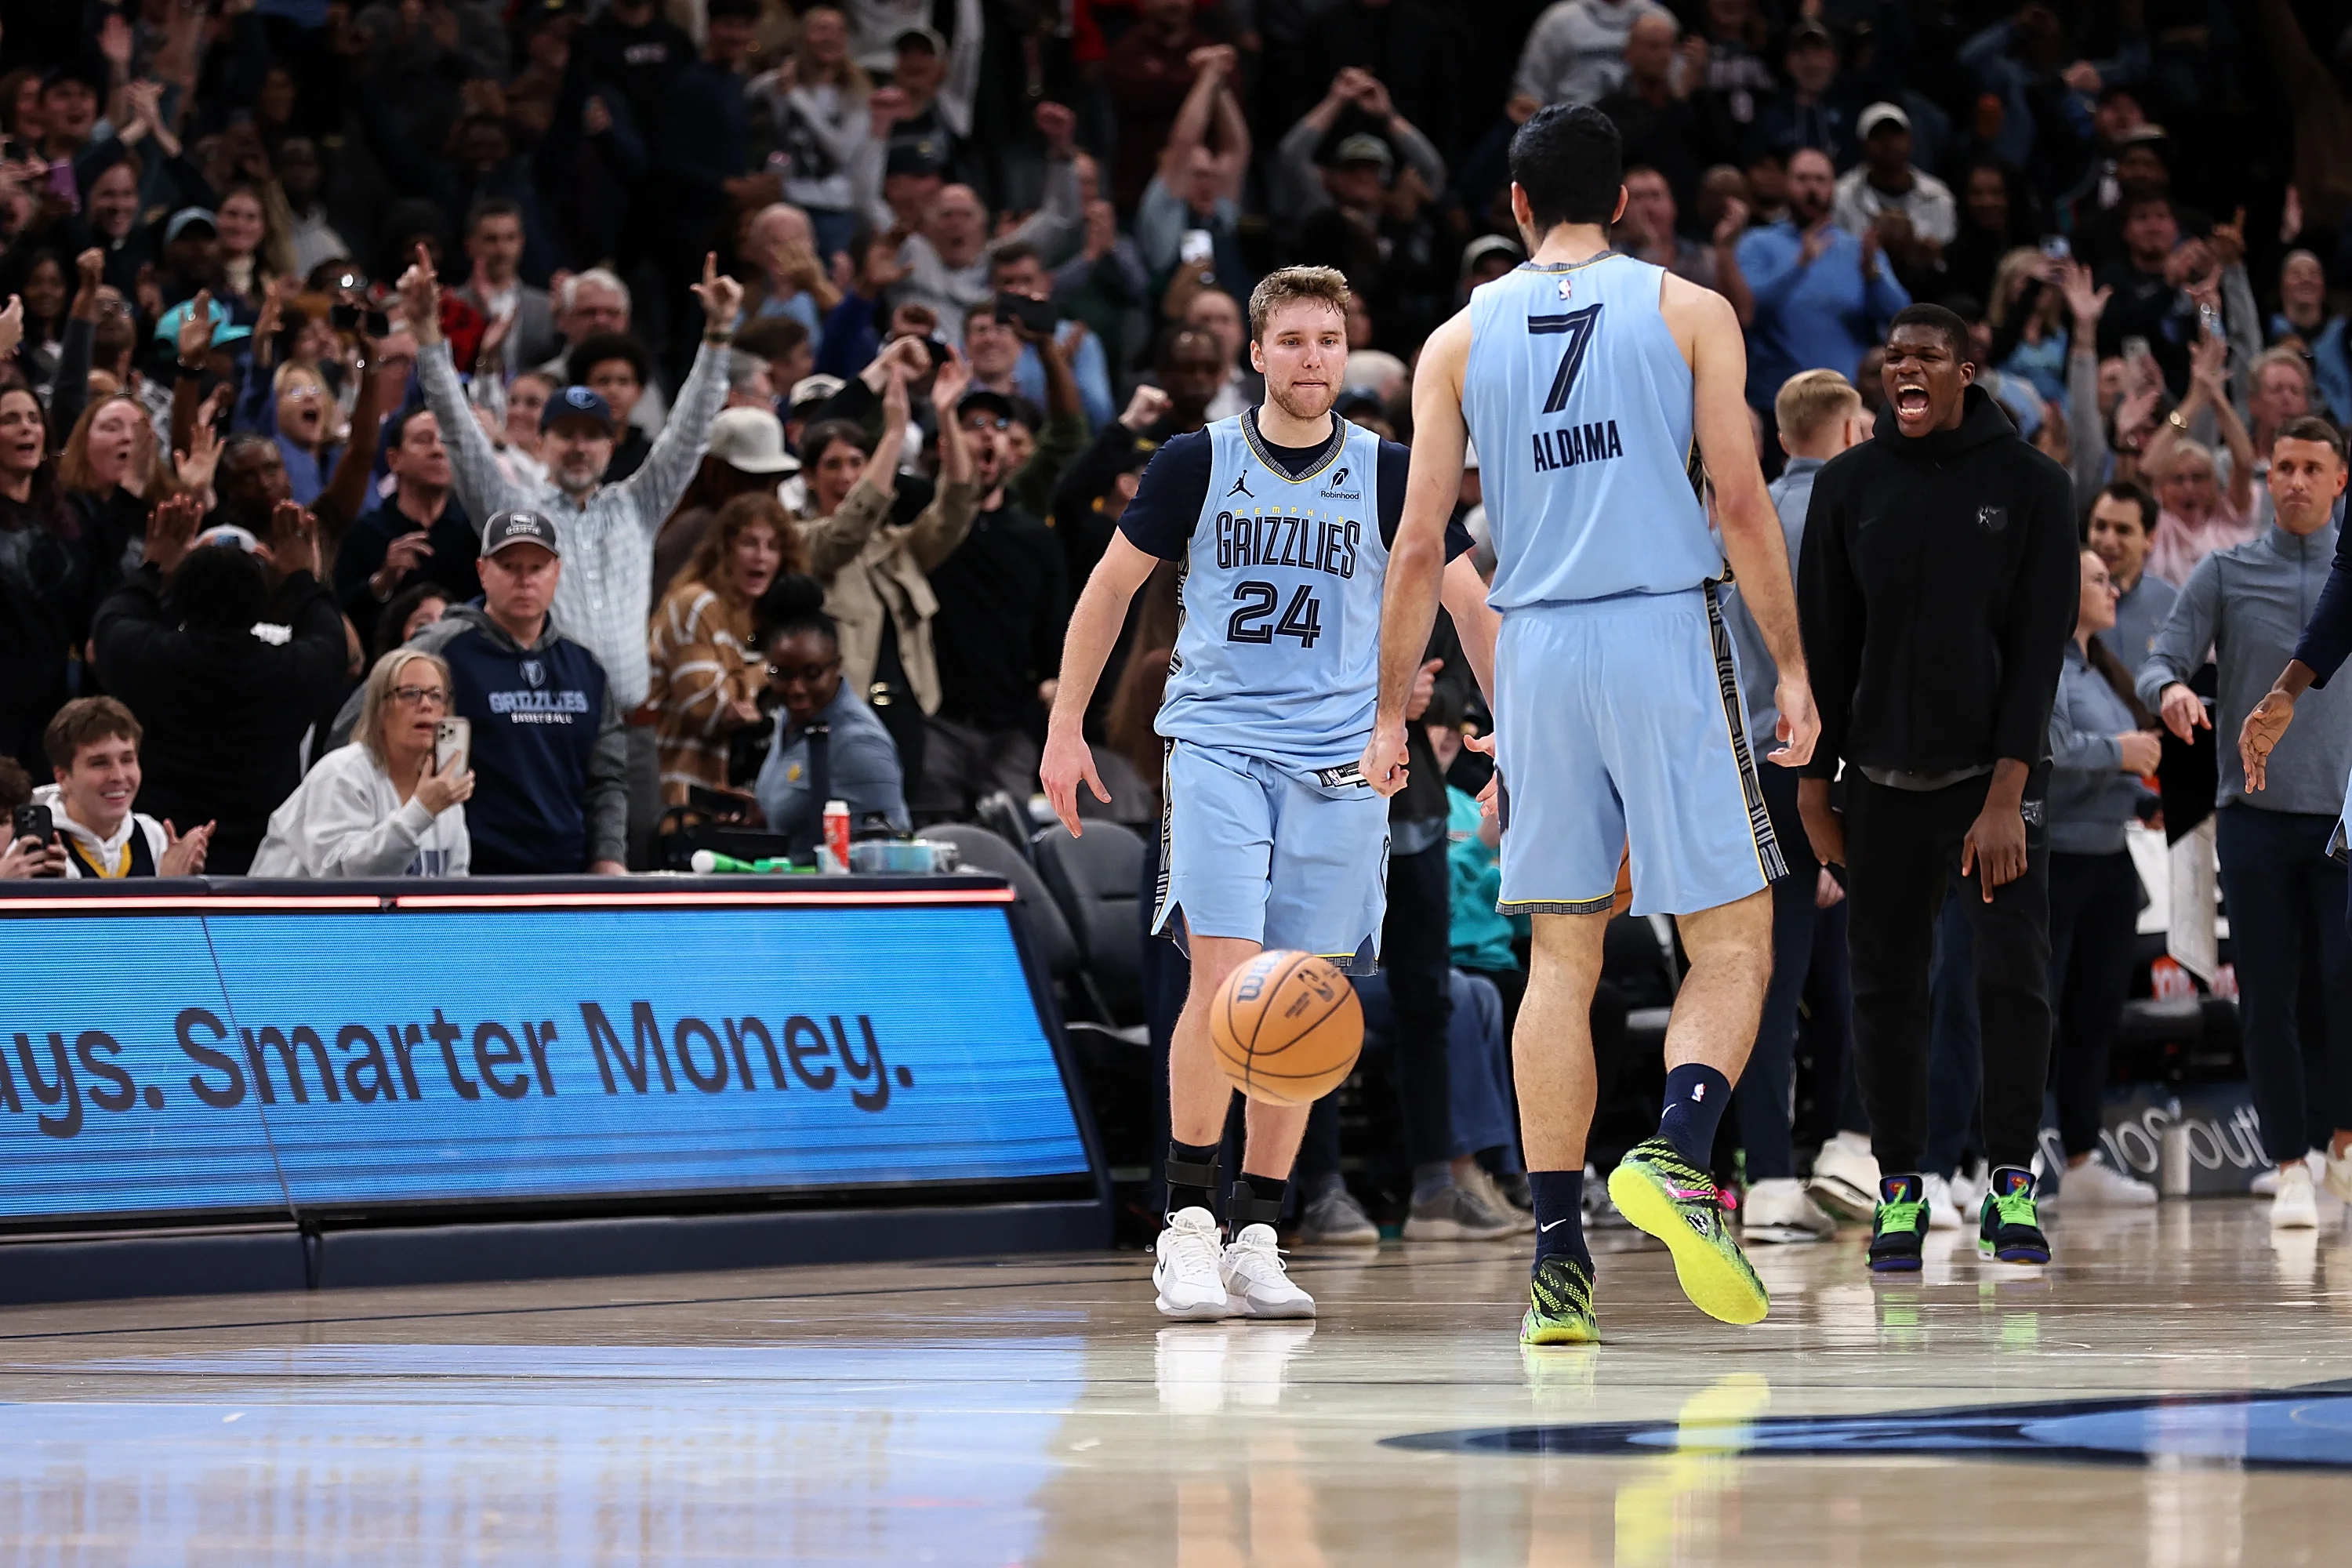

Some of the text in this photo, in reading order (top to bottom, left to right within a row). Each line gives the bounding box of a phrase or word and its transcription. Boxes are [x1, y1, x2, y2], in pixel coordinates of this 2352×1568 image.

[1527, 303, 1604, 415] 7
[1532, 419, 1624, 473] ALDAMA
[1320, 490, 1360, 500] Robinhood
[1215, 510, 1361, 580] GRIZZLIES
[1226, 580, 1322, 649] 24
[488, 690, 590, 714] GRIZZLIES
[510, 712, 575, 724] BASKETBALL
[175, 1007, 559, 1109] Smarter
[579, 1005, 915, 1112] Money.
